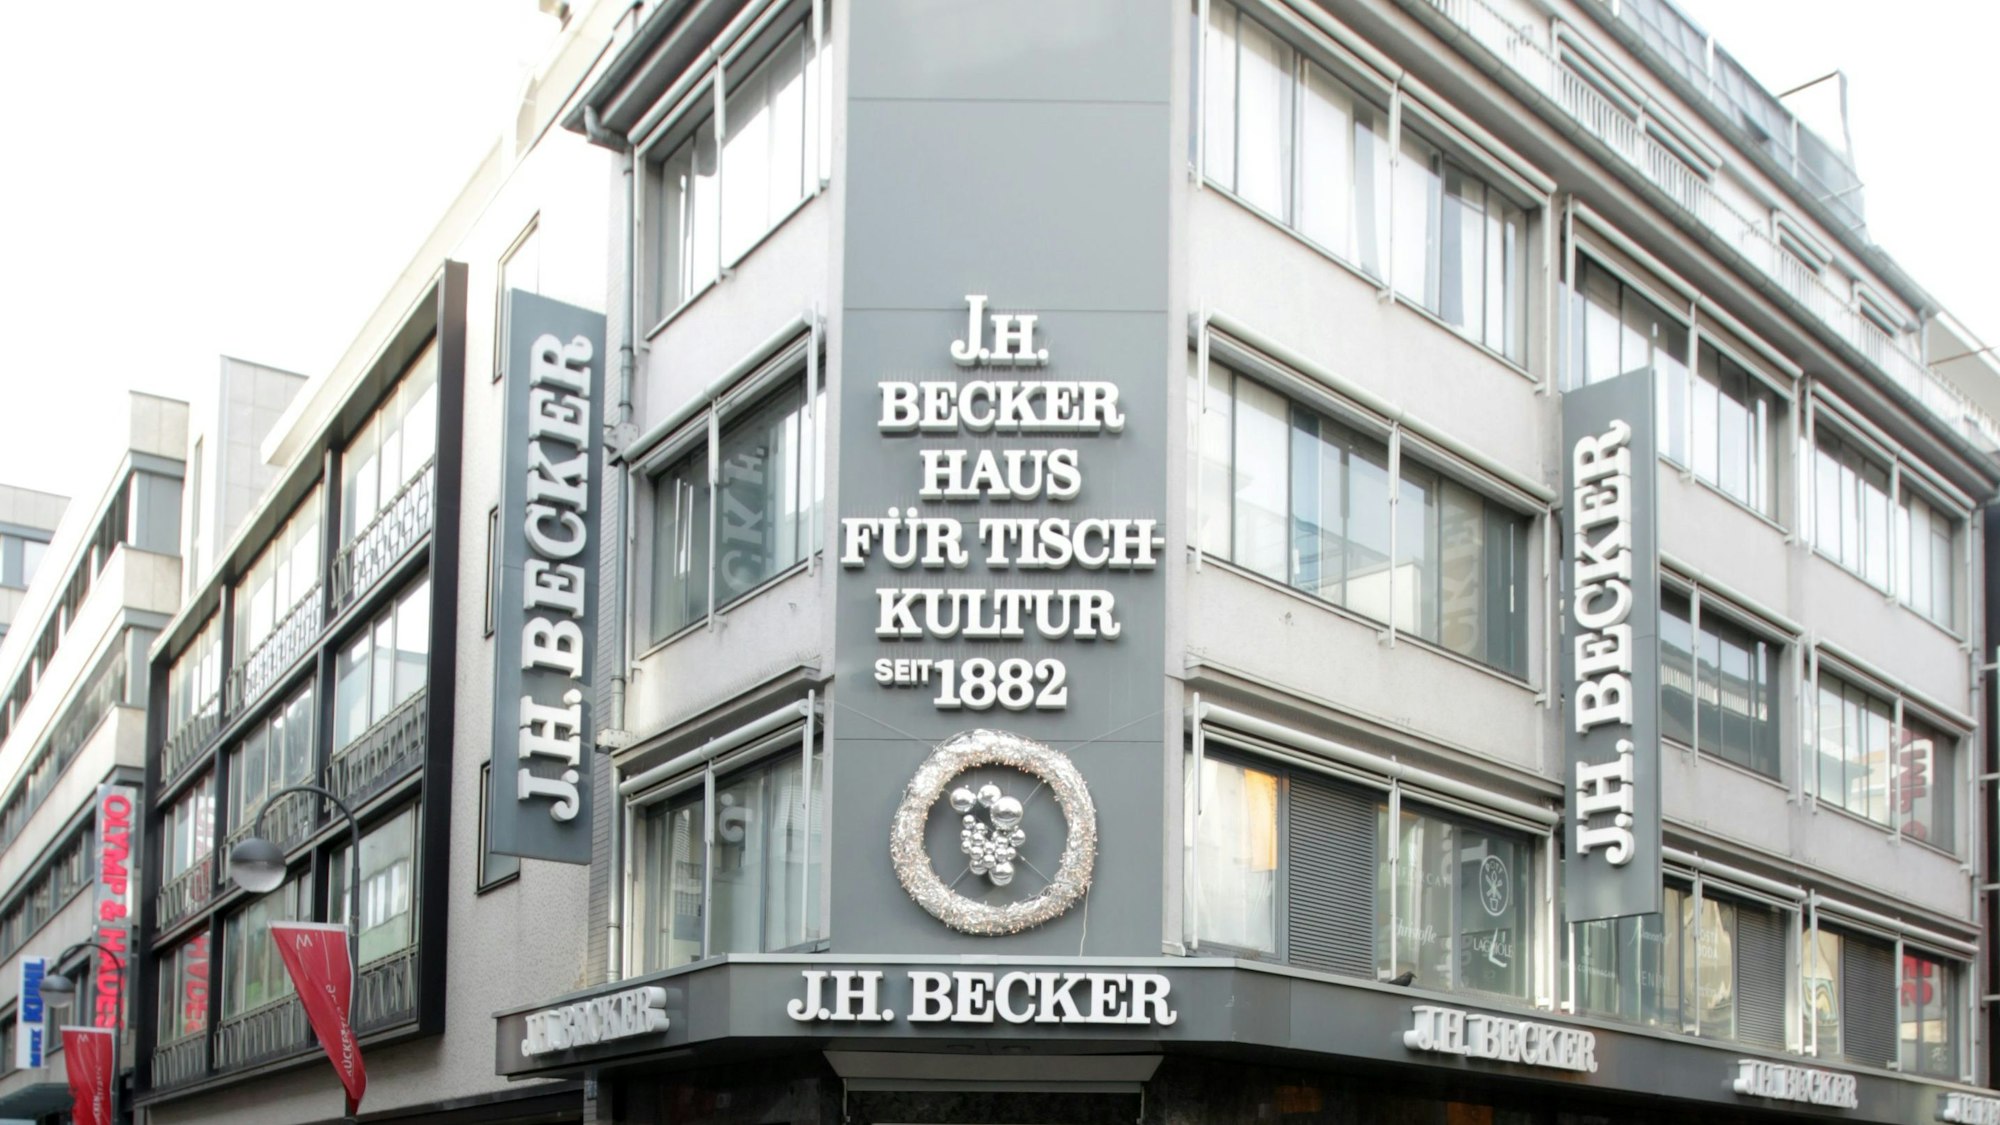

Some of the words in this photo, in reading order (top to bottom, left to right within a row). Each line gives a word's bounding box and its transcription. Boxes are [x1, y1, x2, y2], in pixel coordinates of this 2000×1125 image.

[950, 295, 1049, 366] J.H.
[878, 381, 1125, 432] BECKER
[919, 449, 1081, 500] HAUS
[521, 334, 593, 679] BECKER
[840, 507, 968, 569] FÜR
[979, 518, 1165, 570] TISCH-
[1573, 419, 1632, 733] BECKER
[875, 588, 1121, 640] KULTUR
[874, 659, 934, 687] SEIT
[933, 658, 1068, 710] 1882
[518, 689, 582, 822] J.H.
[1576, 739, 1635, 864] J.H.
[102, 794, 131, 896] OLYMP
[99, 898, 128, 922] &
[557, 986, 670, 1050] BECKER
[787, 970, 895, 1022] J.H.
[907, 971, 1177, 1025] BECKER
[1465, 1014, 1599, 1073] BECKER
[1773, 1064, 1859, 1110] BECKER
